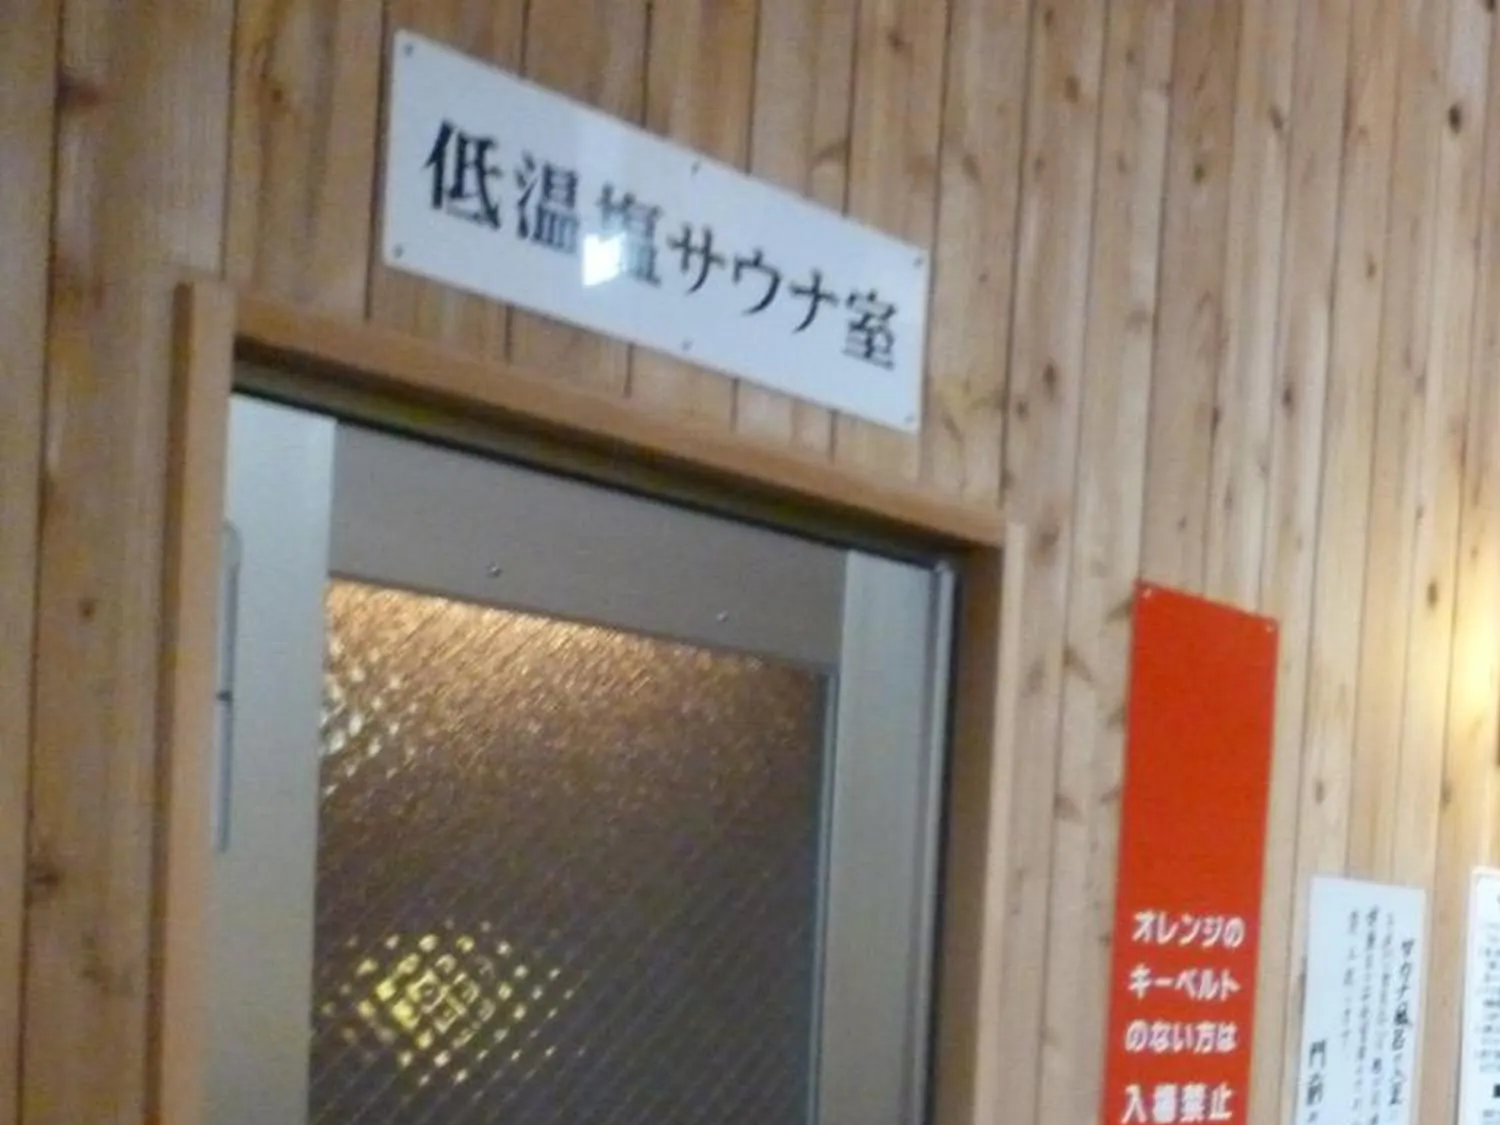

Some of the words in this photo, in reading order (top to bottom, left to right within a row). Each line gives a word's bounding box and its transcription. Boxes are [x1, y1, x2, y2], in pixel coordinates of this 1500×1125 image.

[424, 119, 898, 372] 低温塩サウナ室
[1131, 909, 1246, 949] オレンジの
[1128, 963, 1241, 1000] キーベルト
[1124, 1018, 1238, 1054] のない方は
